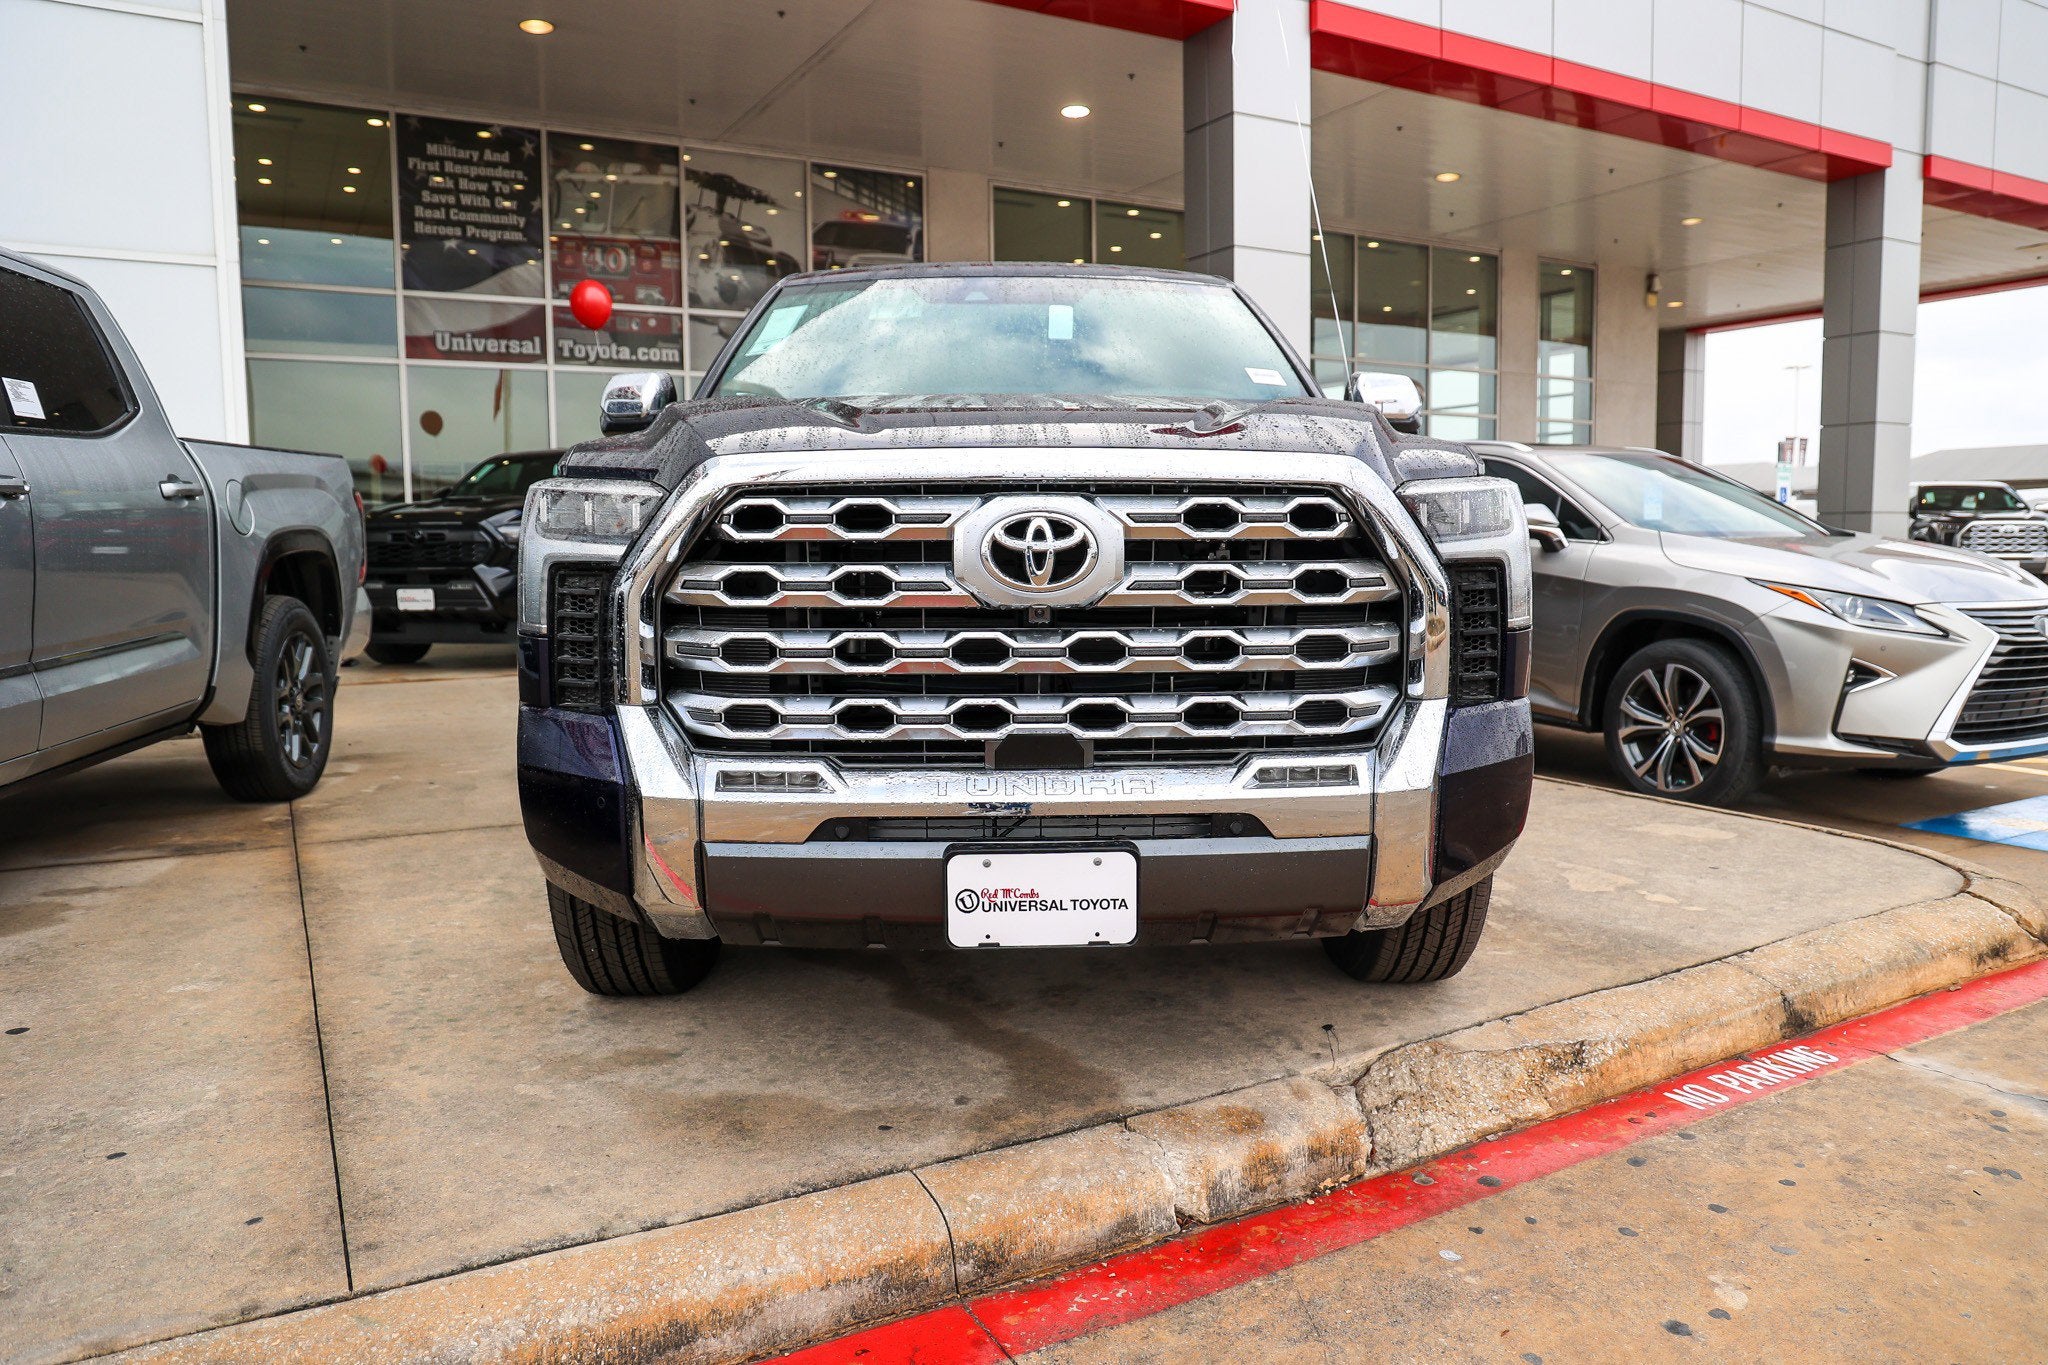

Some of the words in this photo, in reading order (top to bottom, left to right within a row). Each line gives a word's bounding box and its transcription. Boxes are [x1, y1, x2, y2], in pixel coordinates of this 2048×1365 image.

[426, 142, 480, 162] Military
[483, 148, 510, 163] And
[407, 157, 440, 172] First
[458, 178, 489, 191] How
[491, 180, 510, 193] To
[421, 189, 456, 205] Save
[459, 193, 491, 208] With
[494, 196, 518, 210] Or
[414, 205, 446, 219] Real
[449, 207, 526, 228] Community
[414, 221, 462, 236] Heroes
[465, 225, 528, 242] Program.
[434, 331, 541, 354] Universal
[558, 339, 680, 363] Toyota.com
[927, 774, 1155, 797] TUNDRA
[981, 887, 999, 903] Red
[1000, 887, 1040, 899] McCombs
[981, 899, 1068, 913] UNIVERSAL
[1070, 898, 1129, 911] TOYOTA
[1663, 1083, 1730, 1110] NO
[1706, 1045, 1840, 1094] PARKING
